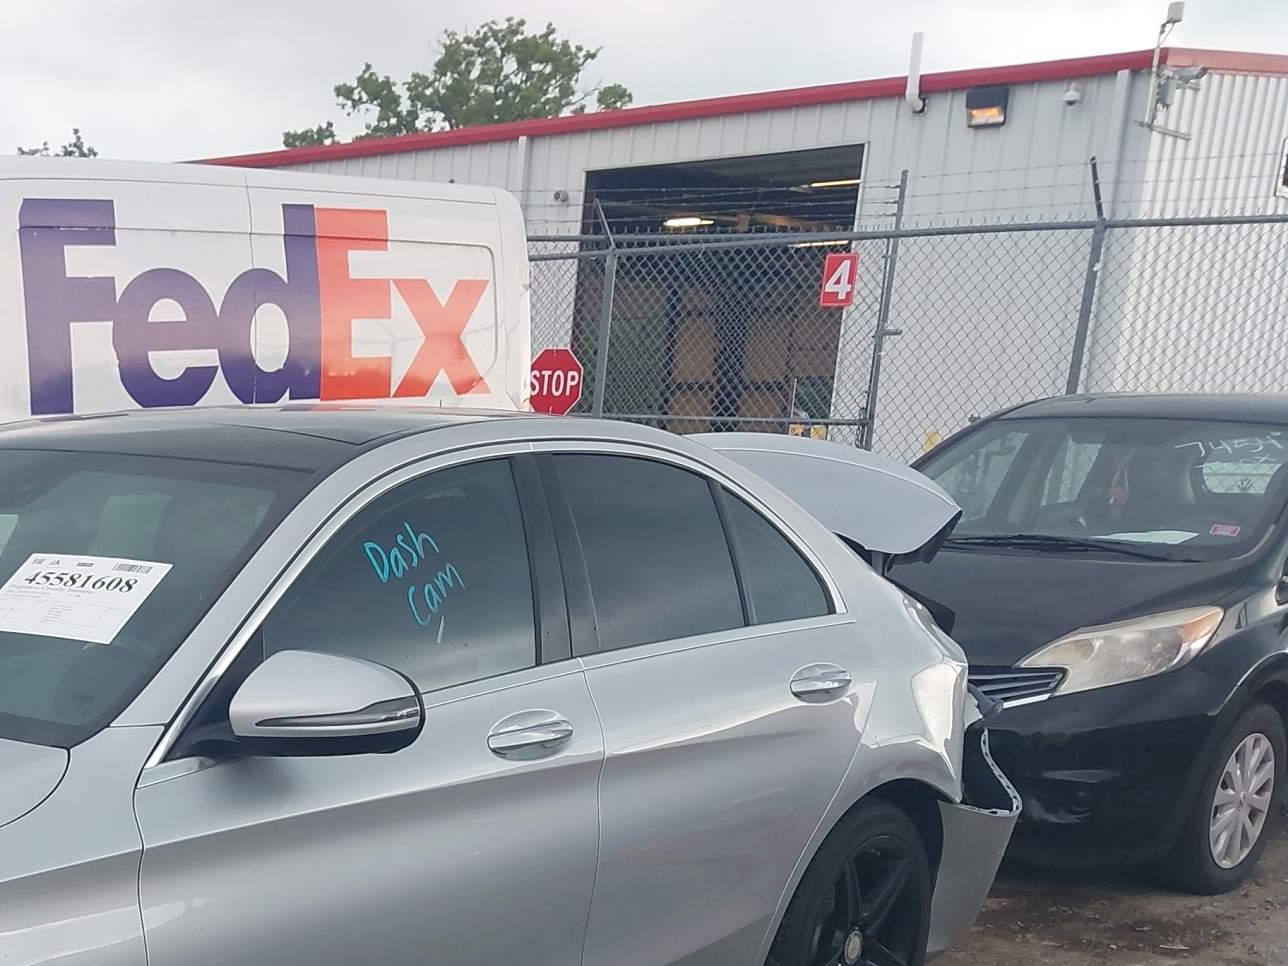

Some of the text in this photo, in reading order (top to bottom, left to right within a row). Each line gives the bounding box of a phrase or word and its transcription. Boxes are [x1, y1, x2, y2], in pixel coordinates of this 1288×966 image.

[825, 260, 851, 299] 4
[19, 198, 490, 416] FedEx
[530, 370, 579, 396] STOP
[363, 521, 440, 583] Dash
[24, 571, 138, 593] 45581608
[408, 562, 466, 626] Cam
